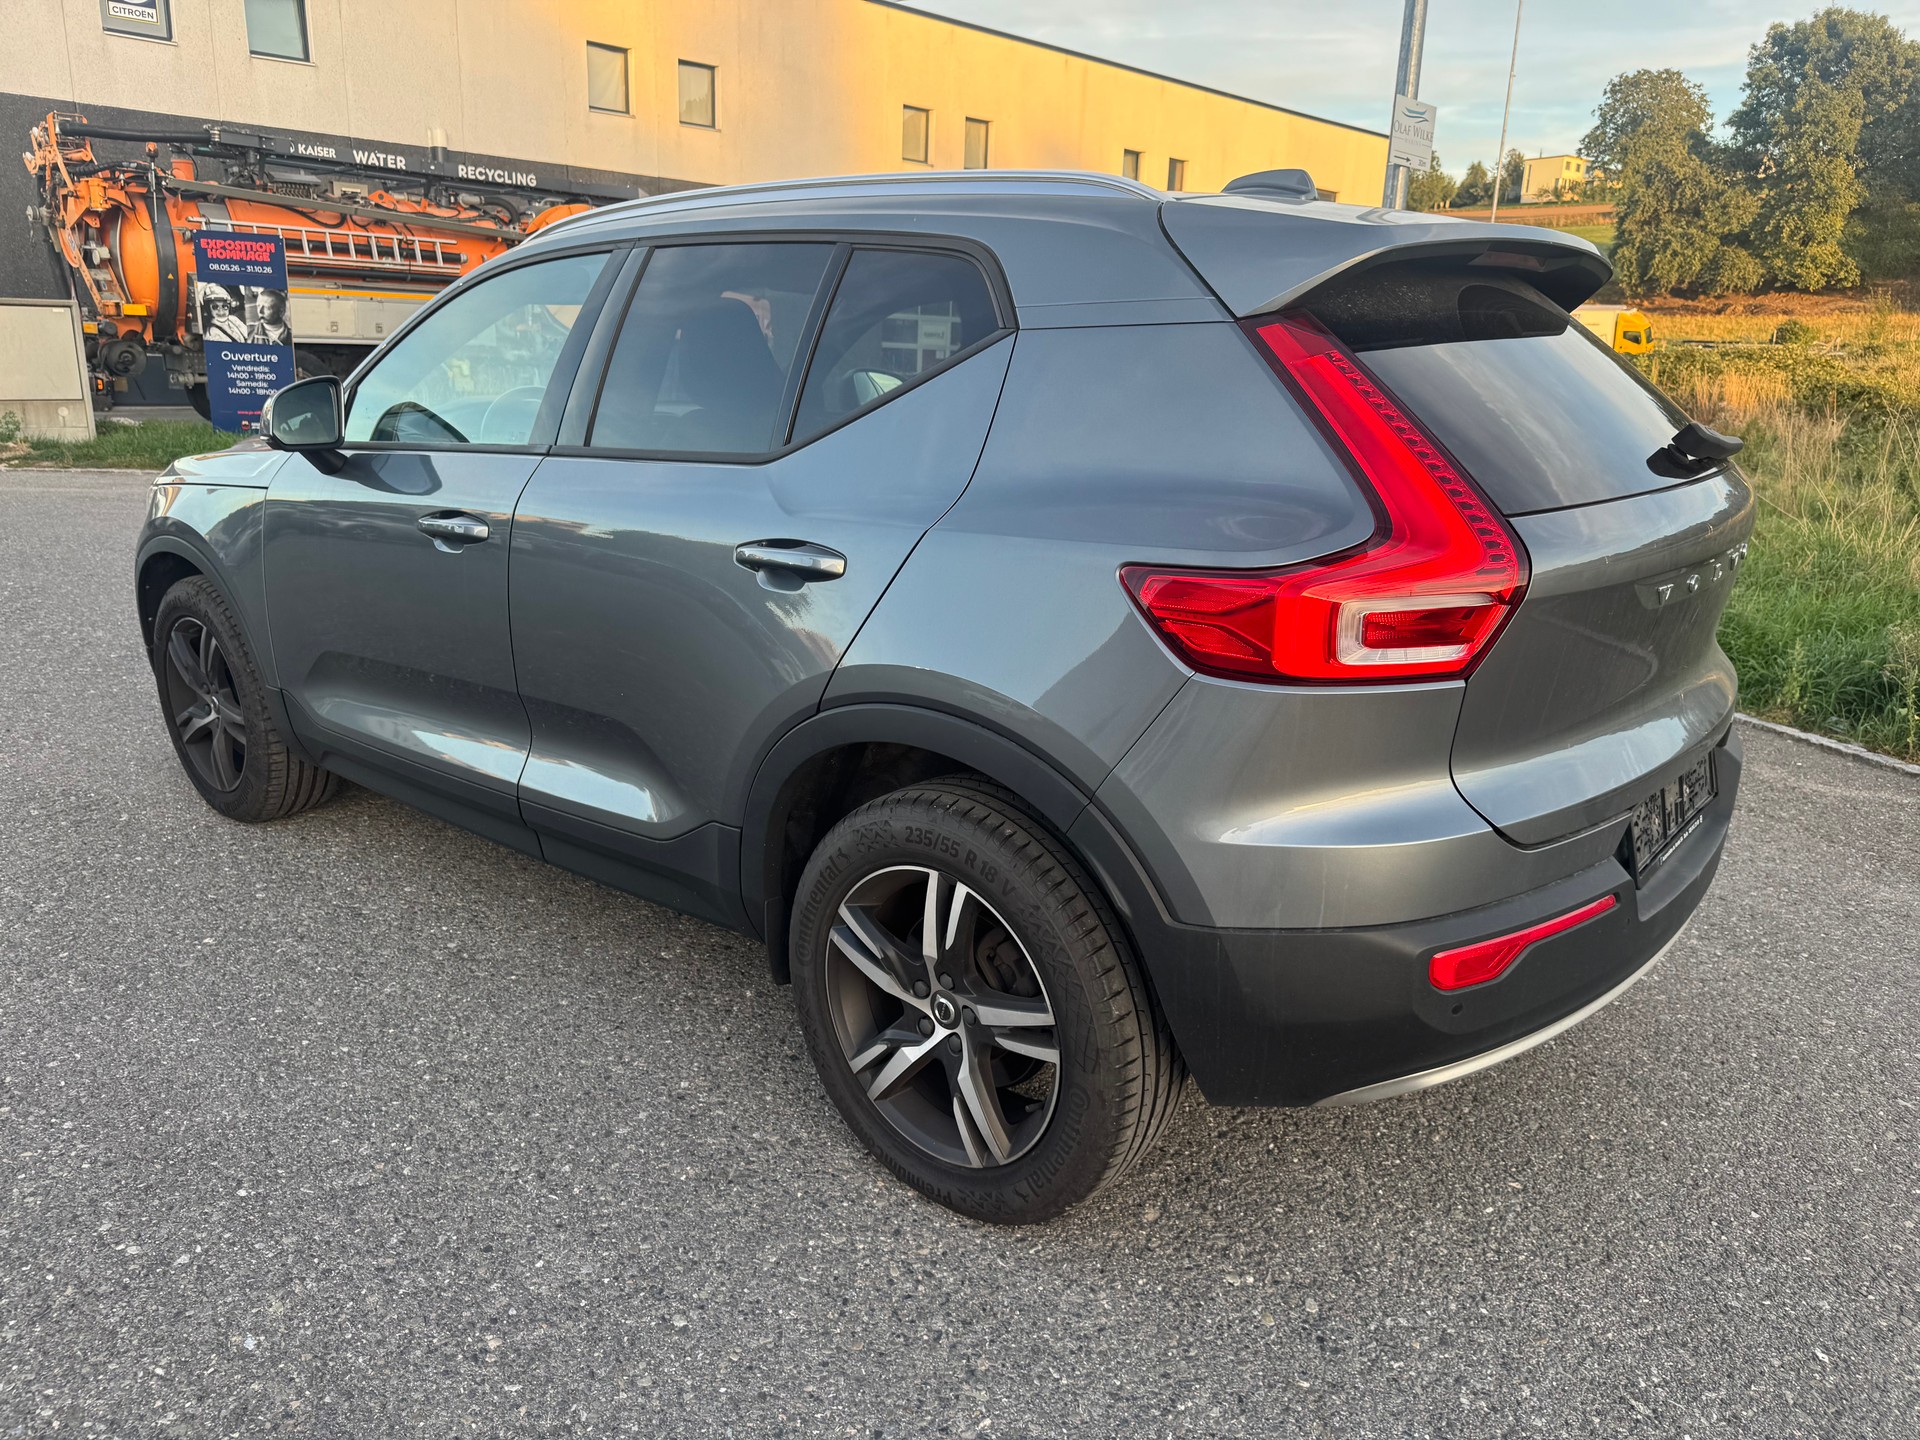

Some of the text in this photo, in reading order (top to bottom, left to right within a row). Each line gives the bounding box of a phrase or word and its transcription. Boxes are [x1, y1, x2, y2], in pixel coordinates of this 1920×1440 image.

[112, 5, 154, 20] CITROËN
[297, 143, 336, 159] KAISER
[352, 149, 407, 170] WATER
[458, 164, 537, 187] RECYCLING
[200, 237, 275, 253] EXPOSITION
[207, 248, 271, 262] HOMMAGE
[209, 263, 240, 272] 08.05.26
[246, 265, 273, 274] 31.10.26
[220, 350, 279, 363] Ouverture
[226, 371, 249, 380] 14h00
[254, 372, 276, 381] 19h00
[231, 364, 270, 373] Vendredis:
[228, 387, 251, 396] 14h00
[236, 380, 269, 388] Samedis:
[904, 825, 1018, 897] 235/55 R 18 V
[798, 852, 845, 964] Continental
[1030, 1085, 1090, 1197] Continental
